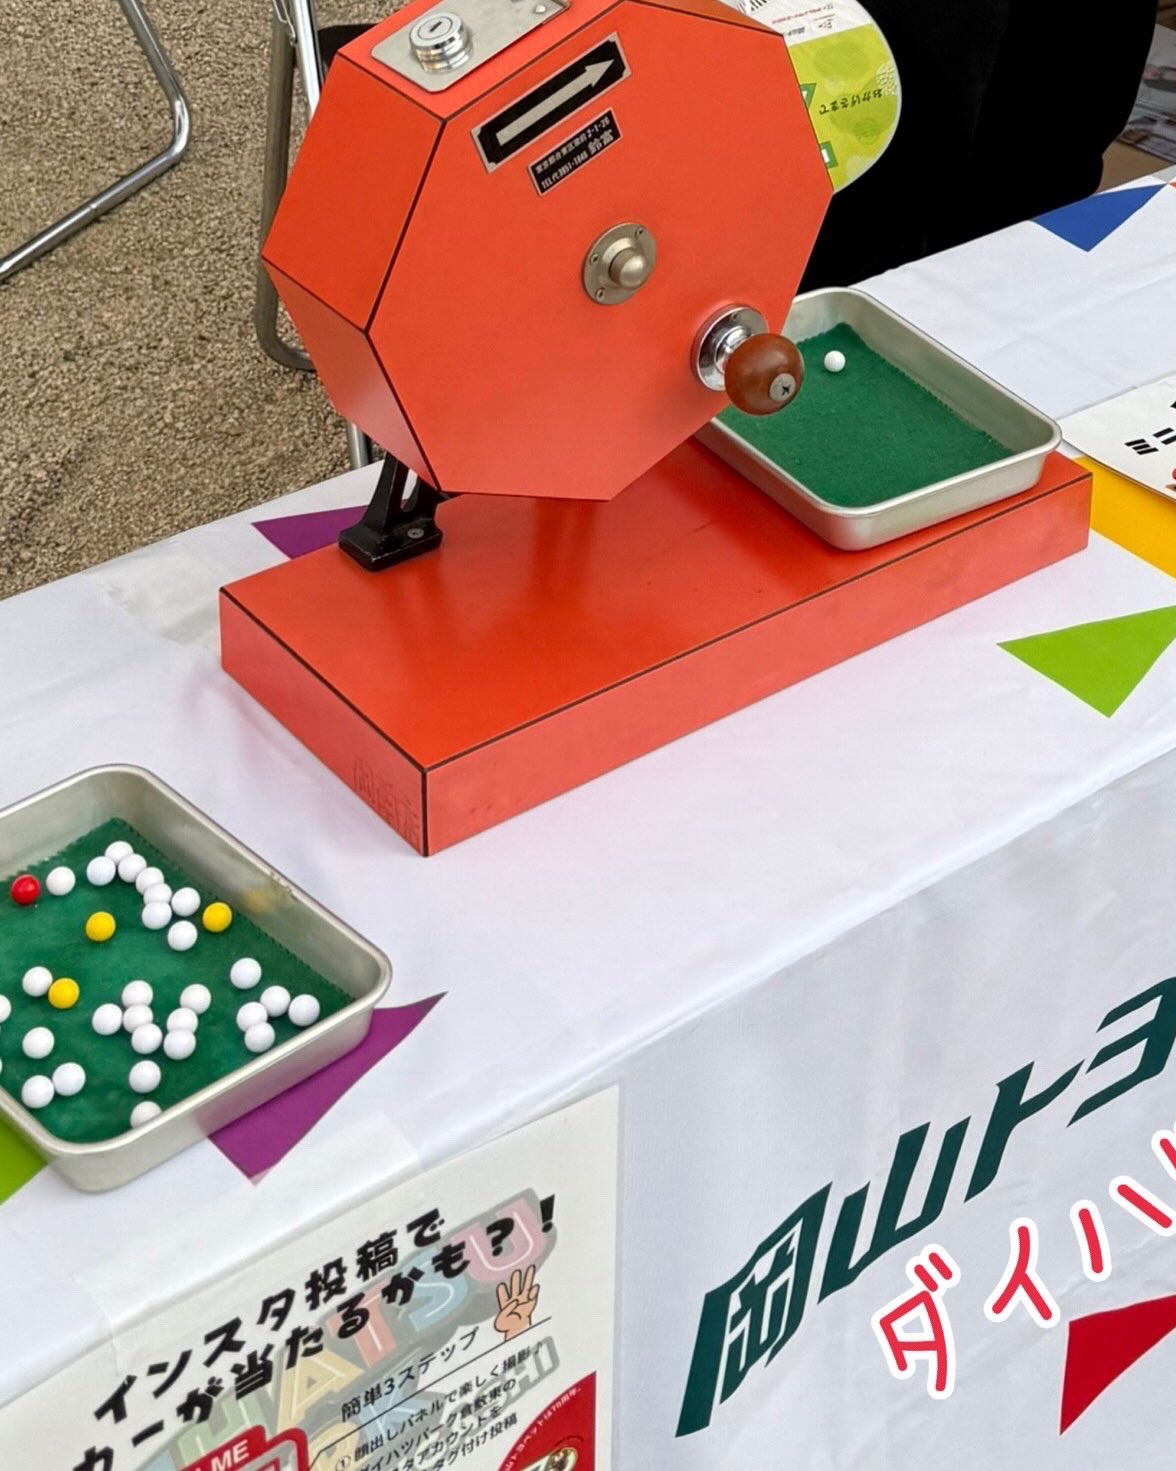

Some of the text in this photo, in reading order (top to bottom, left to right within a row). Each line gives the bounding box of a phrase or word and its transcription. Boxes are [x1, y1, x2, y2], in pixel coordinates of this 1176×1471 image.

[93, 1207, 447, 1425] インスタ投稿で
[341, 1325, 480, 1423] 簡単3ステップ
